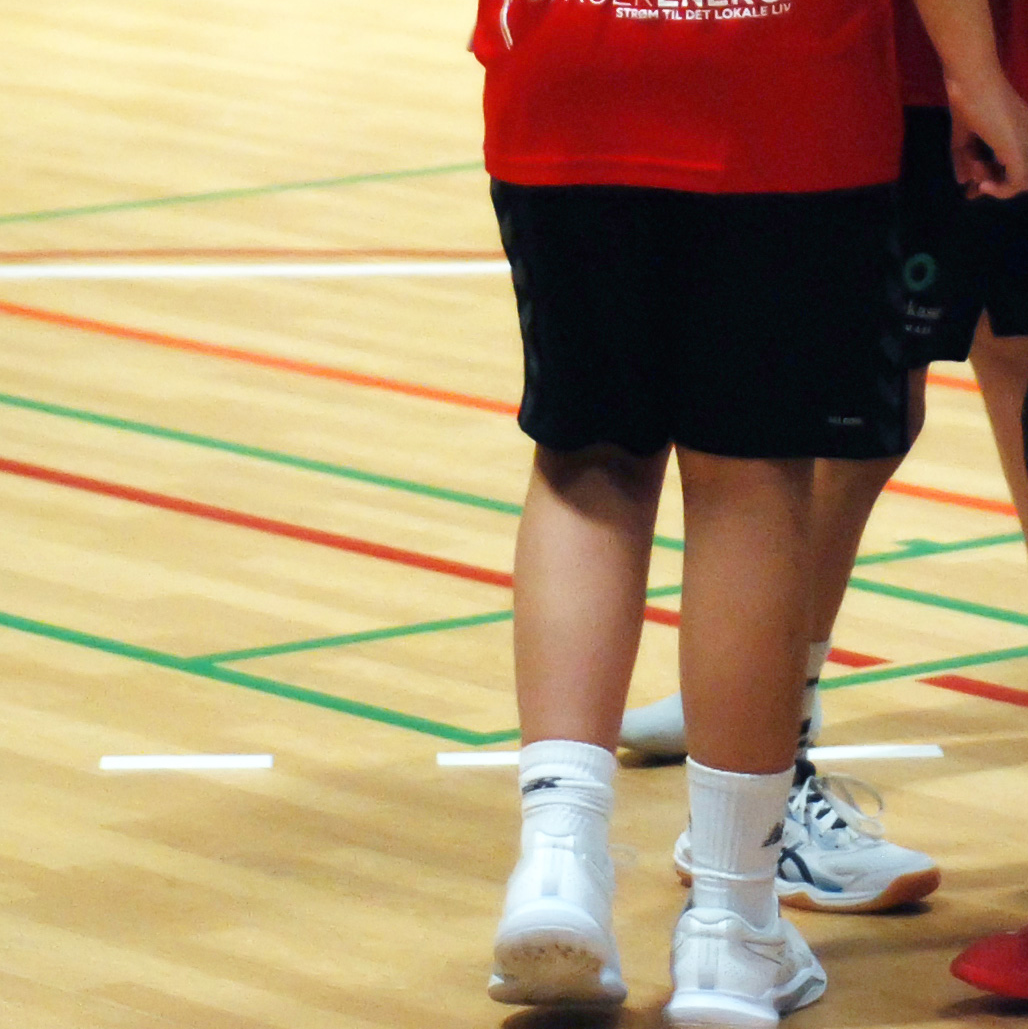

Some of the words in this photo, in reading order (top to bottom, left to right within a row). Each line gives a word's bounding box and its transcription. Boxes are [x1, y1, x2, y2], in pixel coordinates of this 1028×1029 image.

[615, 7, 659, 19] STRØM
[662, 8, 682, 20] TIL
[686, 9, 711, 20] DET
[715, 5, 768, 20] LOKALE
[772, 3, 792, 15] LIV
